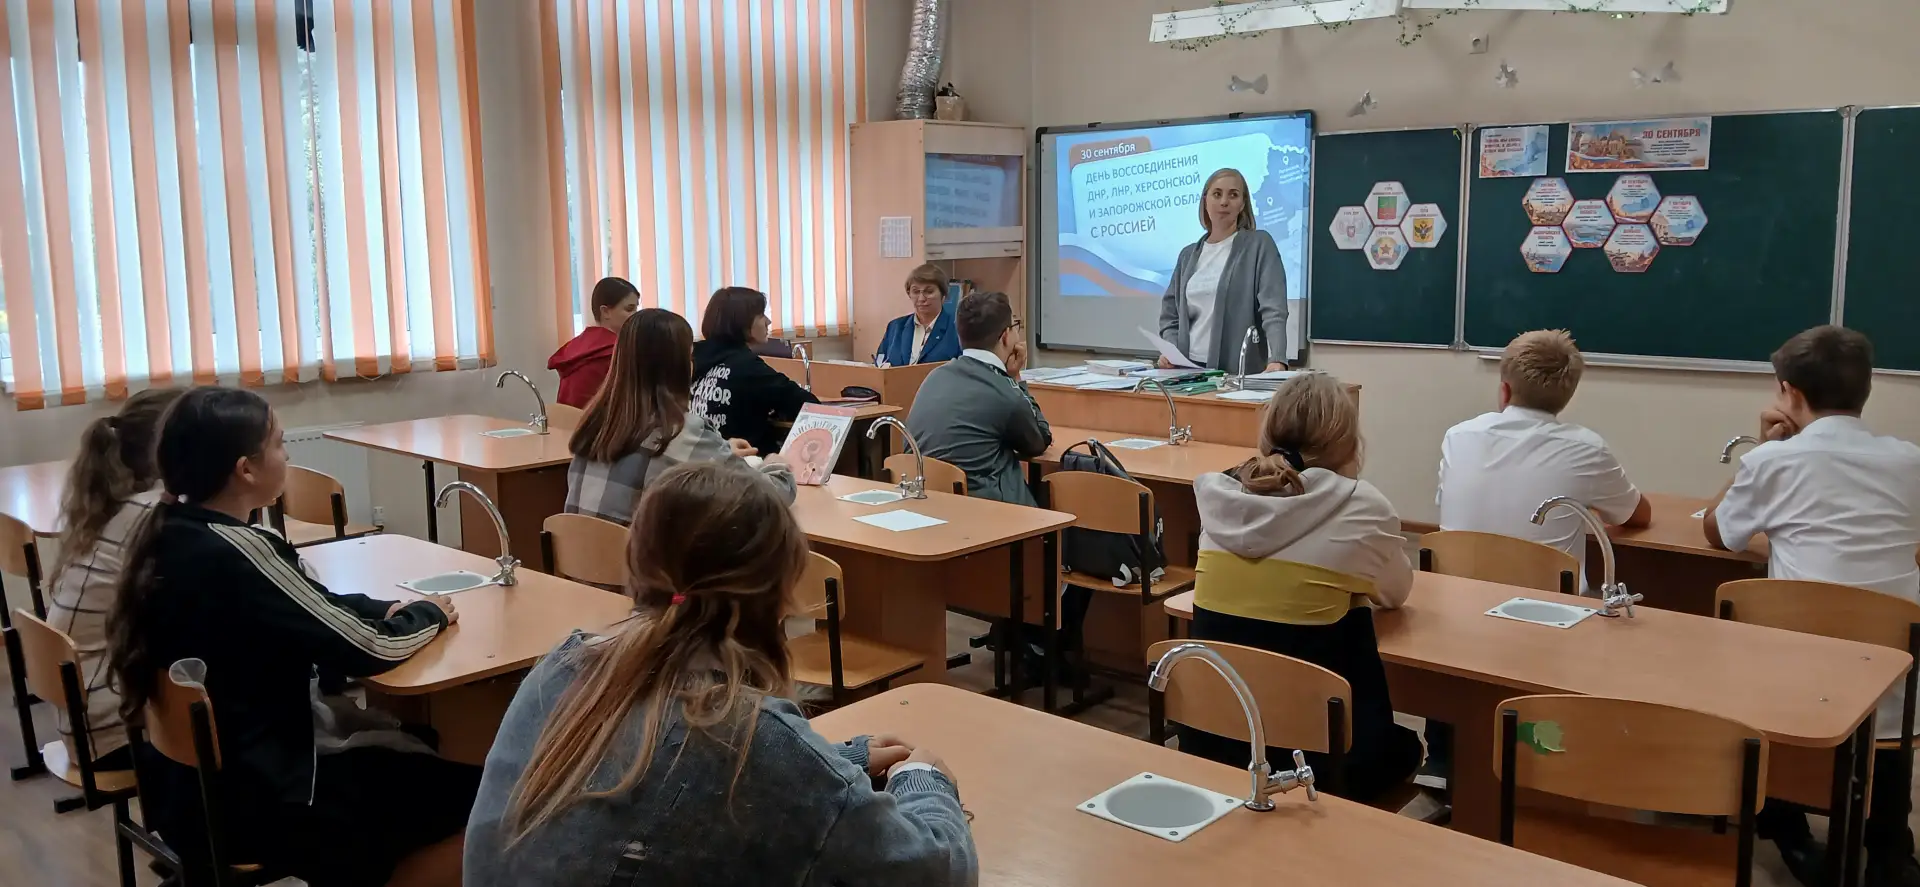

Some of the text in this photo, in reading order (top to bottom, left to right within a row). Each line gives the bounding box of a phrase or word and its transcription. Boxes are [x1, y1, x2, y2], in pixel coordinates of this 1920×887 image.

[1642, 127, 1701, 139] 30 СЕНТЯБРЯ
[1080, 142, 1136, 160] 30 сентября
[1085, 154, 1199, 186] ДЕНЬ ВОССОЕДИНЕНИЯ
[1087, 171, 1201, 203] ДНР, ЛНР, ХЕРСОНСКОЙ
[1088, 209, 1096, 219] И
[1098, 195, 1172, 218] ЗАПОРОЖСКОЙ
[1090, 215, 1156, 239] С РОССИЕЙ
[706, 366, 731, 380] AMOR
[694, 386, 732, 406] AMOR
